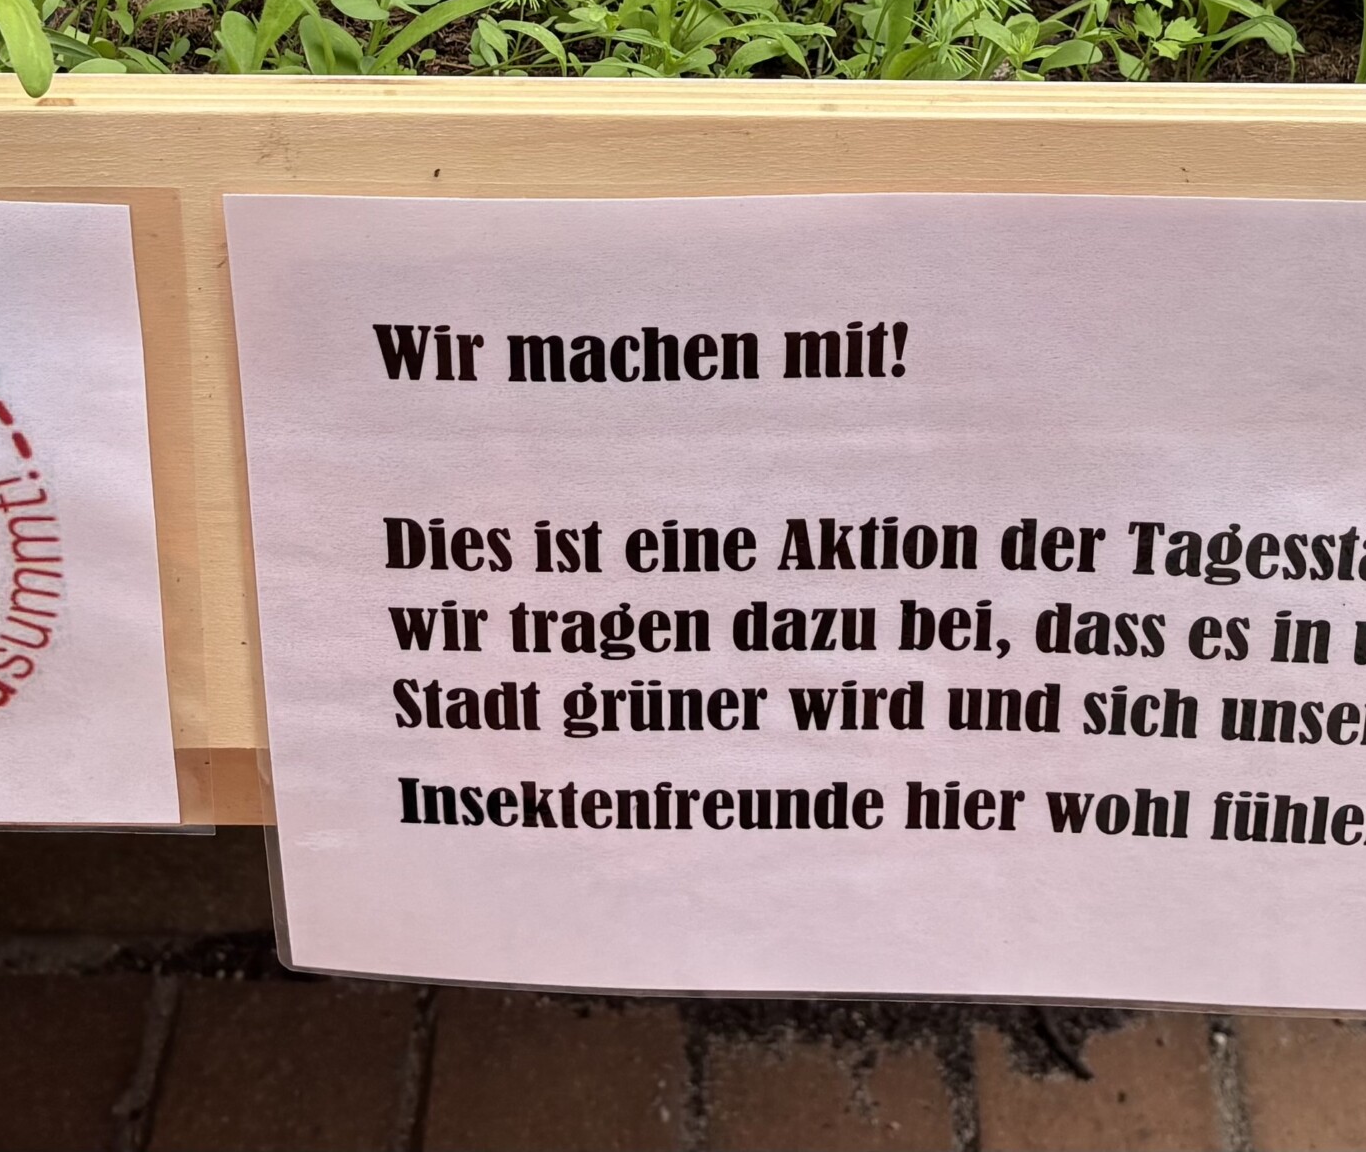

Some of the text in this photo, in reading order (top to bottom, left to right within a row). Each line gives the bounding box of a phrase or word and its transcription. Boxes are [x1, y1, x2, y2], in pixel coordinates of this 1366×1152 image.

[373, 321, 908, 382] Wir machen mit!
[383, 518, 512, 572] Dies
[534, 521, 602, 573] ist
[626, 520, 756, 573] eine
[778, 517, 977, 570] Aktion
[1001, 519, 1105, 572] der
[388, 600, 488, 651] wir
[510, 603, 710, 660] tragen
[733, 602, 876, 651] dazu
[899, 600, 1010, 659] bei,
[1036, 603, 1165, 657] dass
[1189, 617, 1250, 660] es
[1271, 611, 1330, 664] in
[393, 679, 540, 730] Stadt
[564, 680, 767, 738] grüner
[789, 680, 924, 730] wird
[948, 683, 1060, 732] und
[1084, 686, 1197, 738] sich
[398, 778, 883, 830] Insektenfreunde
[905, 781, 1025, 830] hier
[1046, 789, 1189, 838] wohl
